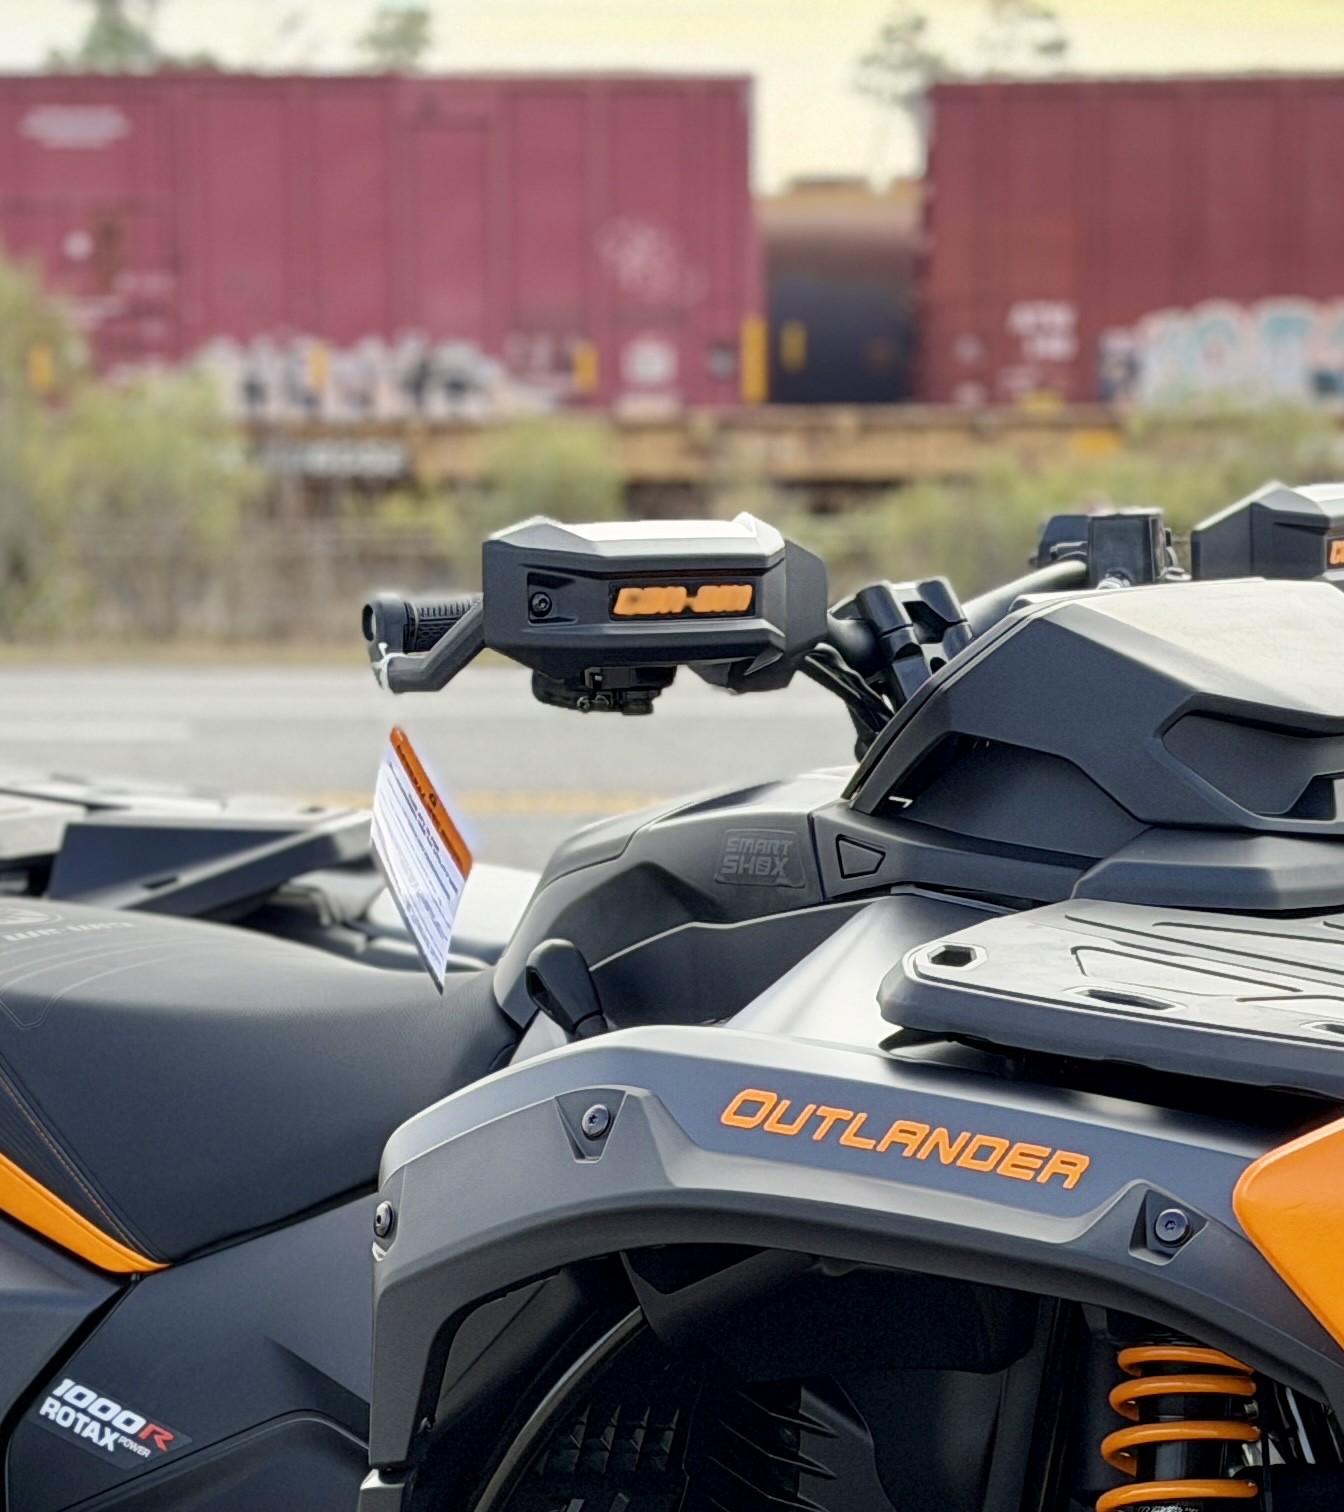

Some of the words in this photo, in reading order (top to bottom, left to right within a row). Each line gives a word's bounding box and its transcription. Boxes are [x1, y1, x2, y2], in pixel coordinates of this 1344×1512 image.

[721, 855, 789, 877] SHOX
[725, 838, 793, 855] SMART
[720, 1088, 1090, 1190] OUTLANDER
[39, 1396, 120, 1452] ROTAX
[117, 1435, 151, 1458] POWER
[52, 1378, 175, 1452] 1000R
